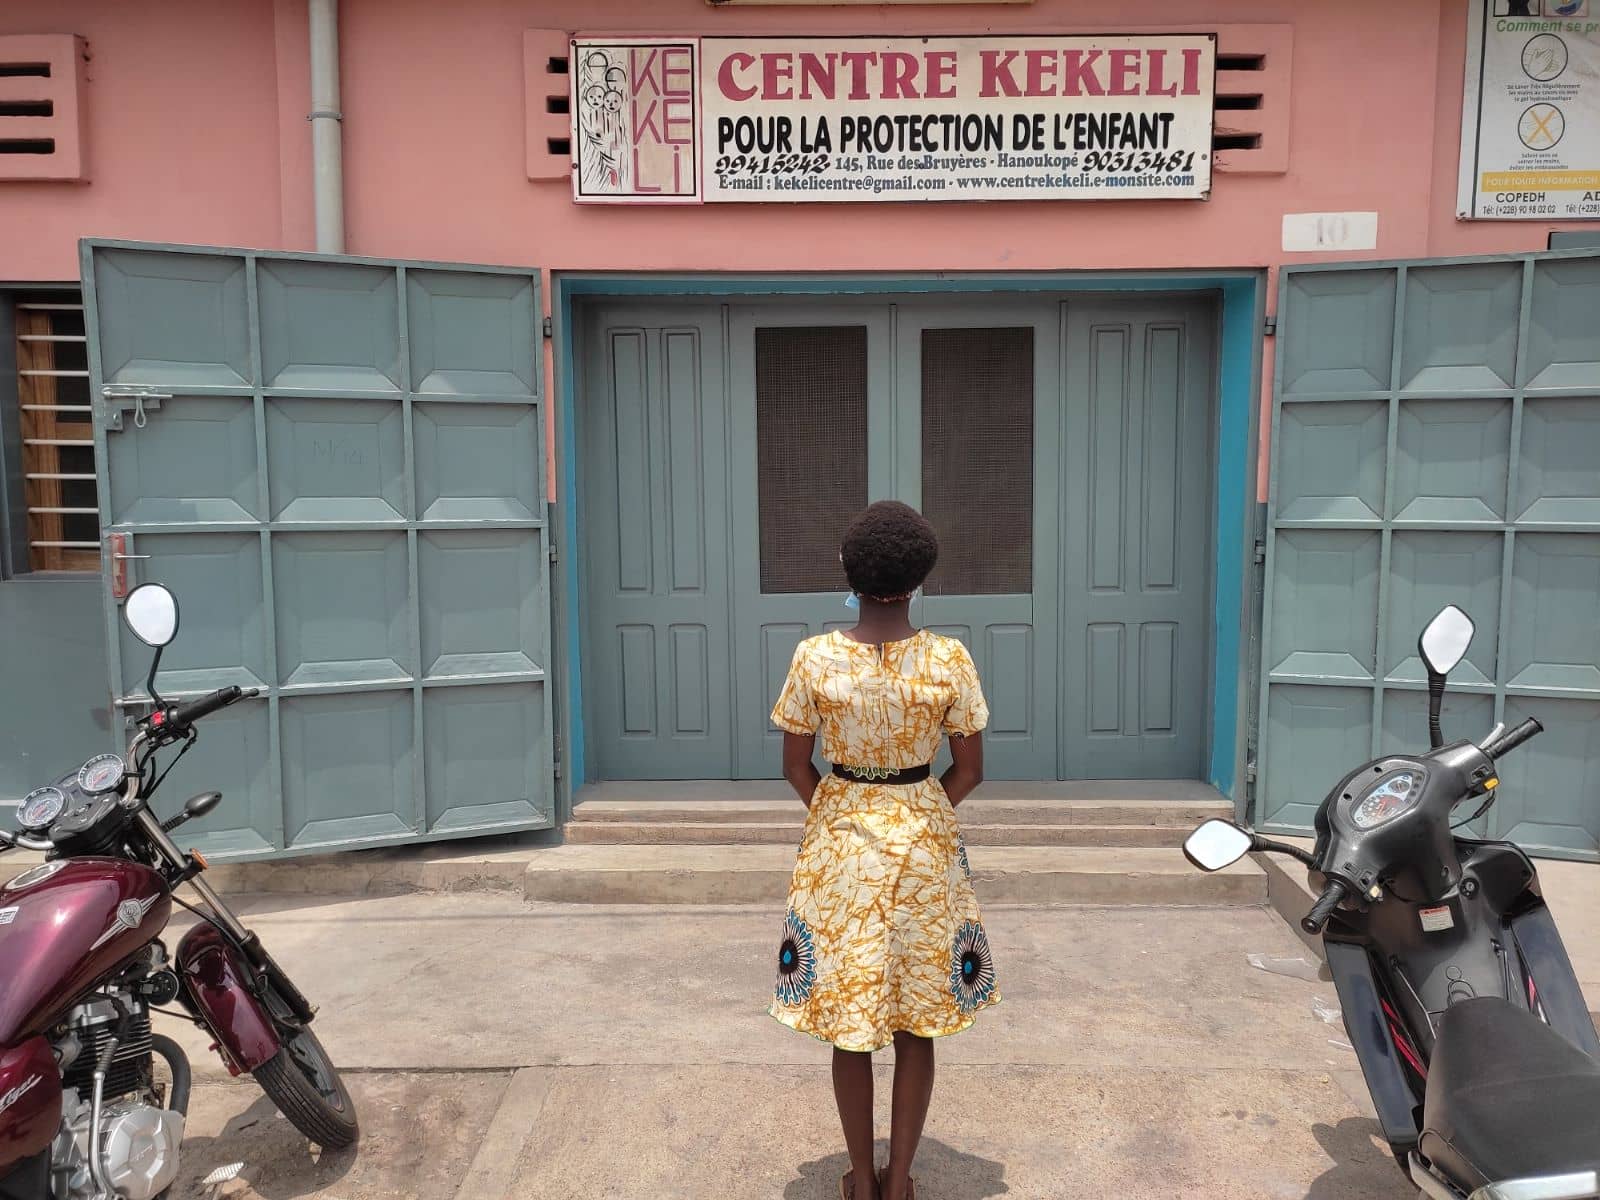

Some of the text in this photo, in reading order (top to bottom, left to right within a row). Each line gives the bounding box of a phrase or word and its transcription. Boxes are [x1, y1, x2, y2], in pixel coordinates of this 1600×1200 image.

[1496, 19, 1562, 32] Comment
[1566, 21, 1581, 32] se
[717, 48, 1201, 102] CENTRE KEKELI
[718, 112, 1175, 154] POUR LA PROTECTION DE L'ENFANT
[714, 154, 831, 175] 99415242
[835, 157, 863, 172] 145,
[867, 155, 894, 170] Rue
[898, 155, 920, 170] des
[923, 154, 987, 172] Bruyères
[997, 152, 1078, 170] Hanoukopé
[719, 174, 763, 190] E-mail
[774, 175, 946, 193] kekelicentre@gmail.com
[957, 172, 1195, 188] www.centrekekeli.e-monsite.com
[1496, 192, 1546, 203] COPEDH
